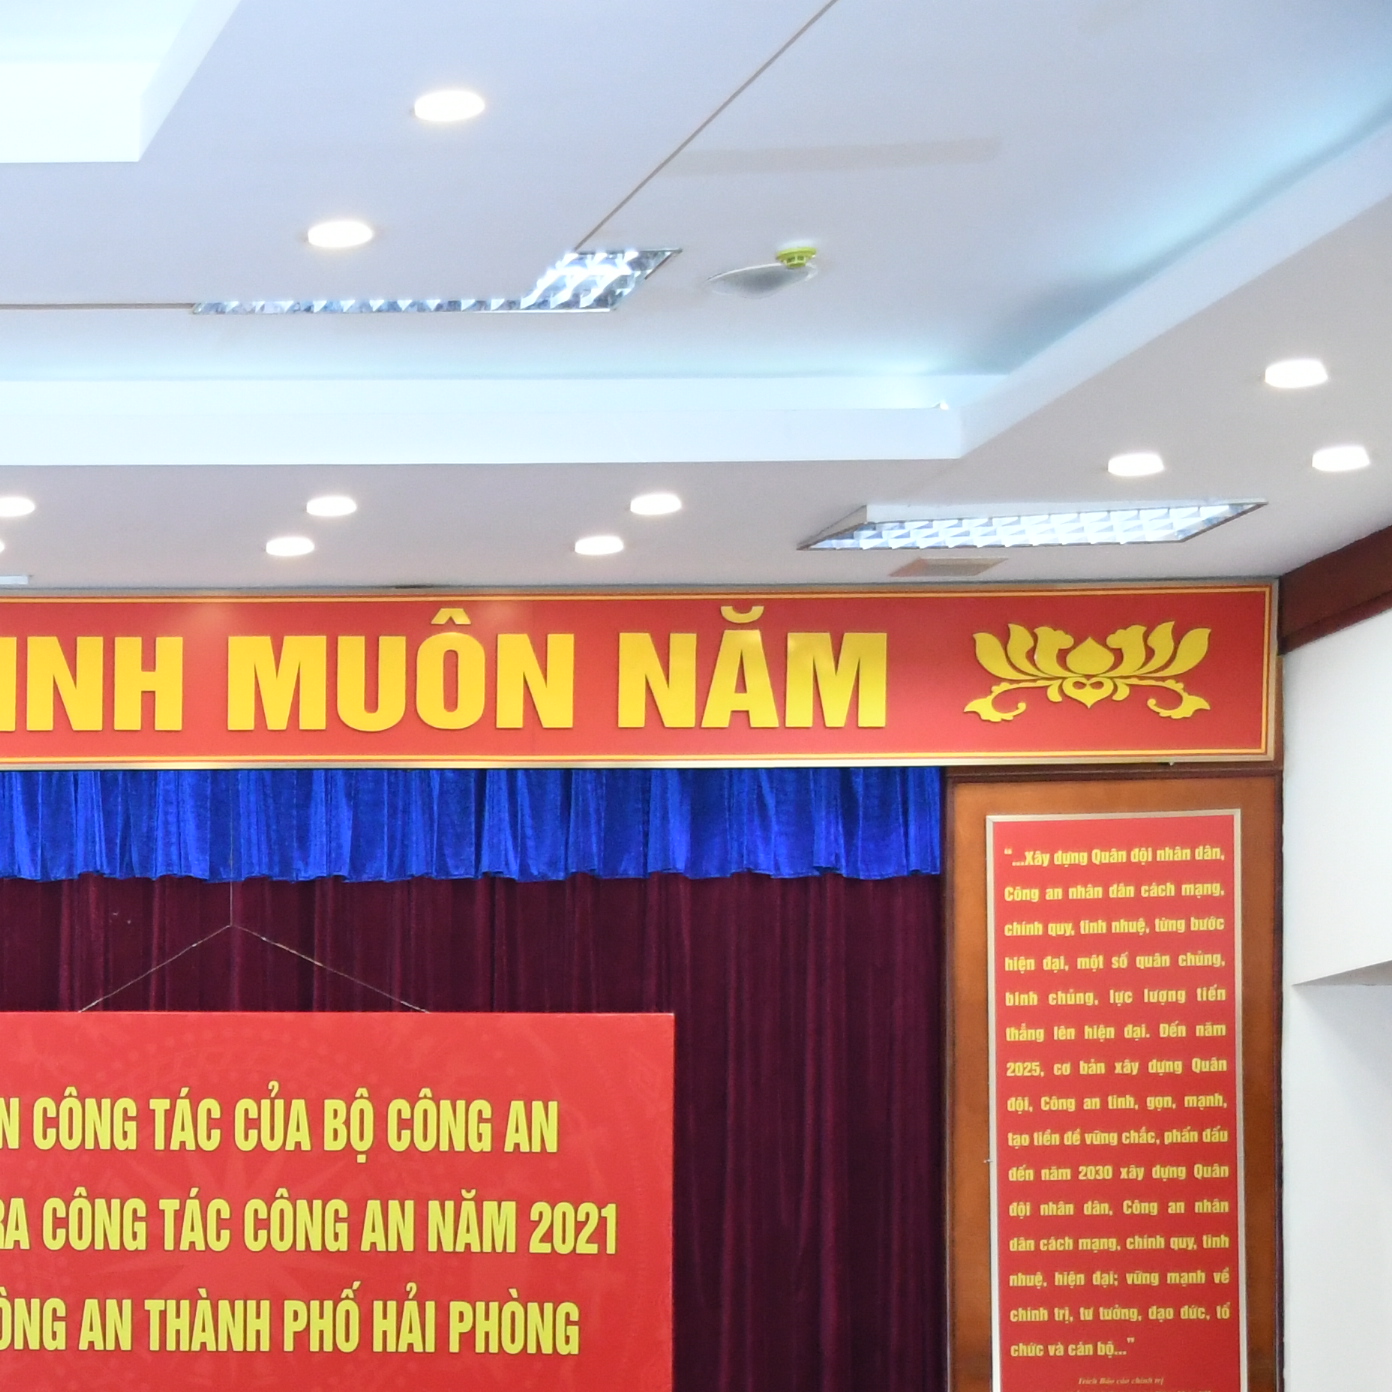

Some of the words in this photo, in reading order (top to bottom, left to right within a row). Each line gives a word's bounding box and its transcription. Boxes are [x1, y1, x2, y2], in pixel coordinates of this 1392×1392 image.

[228, 608, 574, 731] MUÔN
[618, 607, 887, 727] NĂM
[1053, 850, 1089, 868] dựng
[1091, 848, 1127, 865] Quân
[1130, 847, 1153, 865] đội
[1156, 846, 1191, 862] nhân
[1109, 989, 1133, 1007] lực
[1143, 988, 1186, 1006] lượng
[1196, 984, 1226, 1002] tiến
[1006, 1061, 1045, 1077] 2025,
[1053, 1062, 1071, 1076] cơ
[1079, 1058, 1106, 1075] bản
[1114, 1059, 1139, 1076] xây
[1148, 1059, 1183, 1075] dựng
[1191, 1057, 1227, 1074] Quân
[34, 1087, 136, 1150] CÔNG
[150, 1088, 220, 1151] TÁC
[235, 1081, 311, 1151] CỦA
[324, 1088, 373, 1163] BỘ
[388, 1088, 491, 1152] CÔNG
[504, 1101, 557, 1152] AN
[1008, 1164, 1035, 1182] đến
[1041, 1166, 1071, 1181] năm
[1078, 1165, 1113, 1180] 2030
[1120, 1164, 1145, 1181] xây
[1151, 1164, 1186, 1182] dựng
[1193, 1163, 1229, 1179] Quân
[1008, 1201, 1031, 1220] đội
[1039, 1200, 1075, 1216] nhân
[1122, 1199, 1158, 1216] Công
[1167, 1201, 1185, 1214] an
[1194, 1198, 1229, 1213] nhân
[43, 1187, 146, 1250] CÔNG
[159, 1188, 230, 1251] TÁC
[245, 1188, 348, 1251] CÔNG
[361, 1200, 414, 1251] AN
[428, 1189, 516, 1252] NĂM
[530, 1202, 616, 1254] 2021
[79, 1299, 131, 1350] AN
[145, 1288, 270, 1351] THÀNH
[284, 1281, 360, 1352] PHỐ
[373, 1283, 435, 1352] HẢI
[450, 1289, 579, 1354] PHÒNG
[1010, 1342, 1045, 1357] chức
[1047, 1341, 1065, 1357] và
[1067, 1341, 1094, 1356] cán
